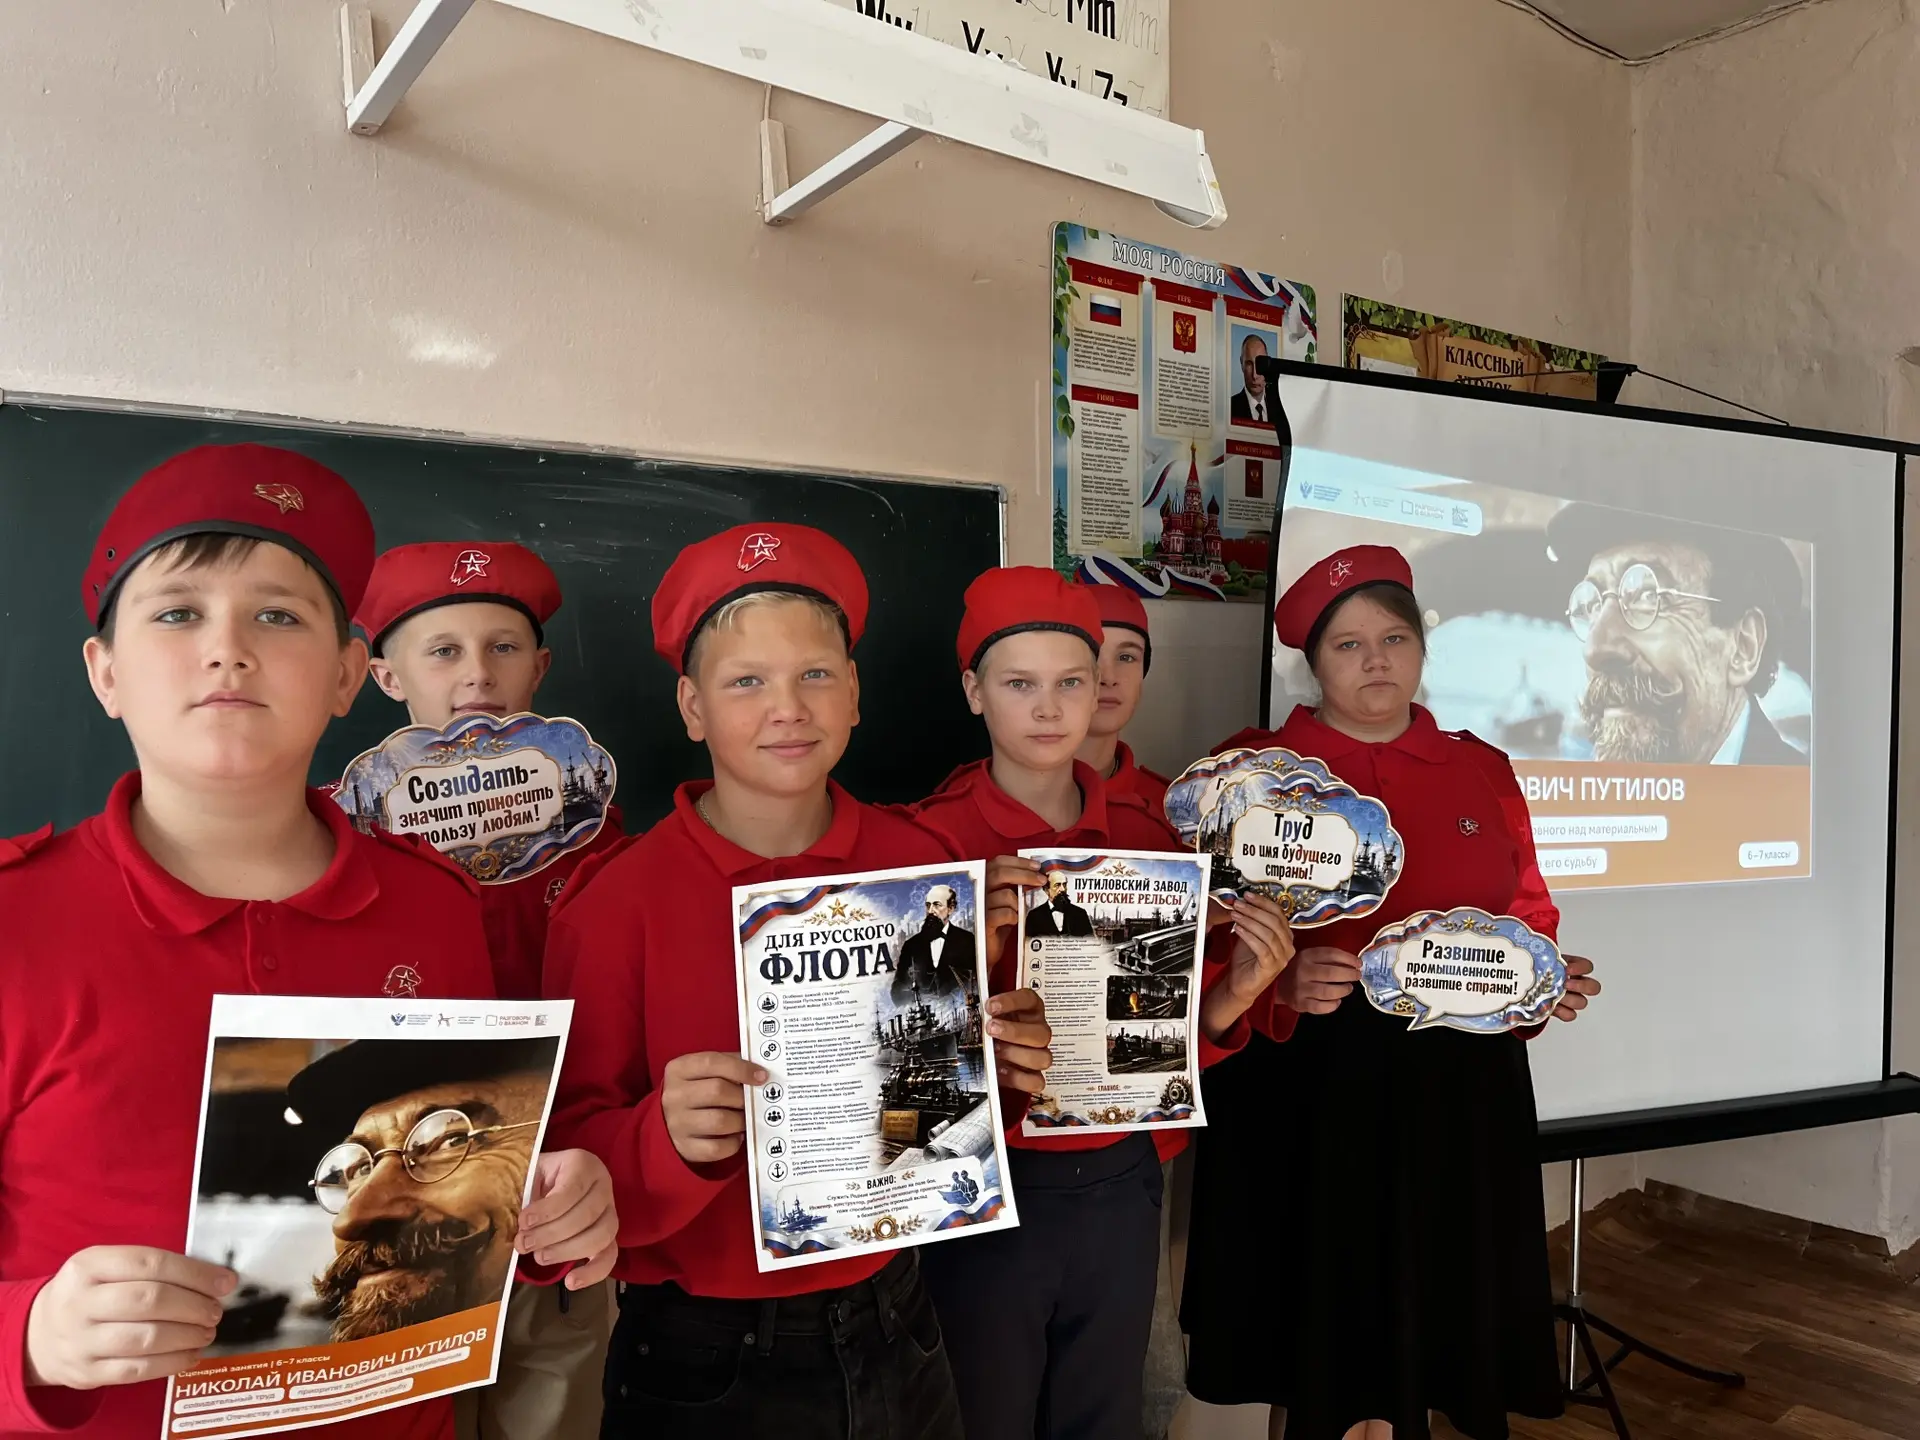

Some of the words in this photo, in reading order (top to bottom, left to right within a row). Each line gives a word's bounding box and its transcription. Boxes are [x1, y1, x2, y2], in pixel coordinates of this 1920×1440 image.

[1112, 240, 1153, 270] МОЯ
[1160, 252, 1226, 287] РОССИЯ
[1445, 345, 1524, 377] КЛАССНЫЙ
[1581, 777, 1685, 801] ПУТИЛОВ
[399, 803, 463, 828] значит
[467, 786, 554, 817] приносить
[483, 804, 540, 835] людям!
[1274, 813, 1314, 841] Труд
[1569, 825, 1586, 836] над
[1589, 824, 1658, 836] материальным
[1242, 843, 1256, 856] во
[1259, 844, 1279, 858] имя
[1282, 844, 1342, 865] будущего
[1544, 859, 1562, 870] его
[1565, 857, 1597, 870] судьбу
[1765, 849, 1791, 860] классы
[1265, 861, 1313, 881] страны!
[1074, 876, 1150, 892] ПУТИЛОВСКИЙ
[1153, 880, 1188, 893] ЗАВОД
[1076, 893, 1084, 904] И
[1087, 892, 1134, 904] РУССКИЕ
[1137, 893, 1182, 906] РЕЛЬСЫ
[764, 932, 805, 952] ДЛЯ
[810, 923, 895, 946] РУССКОГО
[1422, 940, 1505, 964] Развитие
[759, 942, 897, 986] ФЛОТА
[1404, 977, 1463, 992] развитие
[1466, 981, 1518, 996] страны!
[867, 1174, 896, 1189] ВАЖНО:
[175, 1371, 281, 1398] НИКОЛАЙ
[287, 1352, 396, 1385] ИВАНОВИЧ
[401, 1327, 487, 1361] ПУТИЛОВ
[178, 1366, 228, 1378] Сценарий
[230, 1362, 268, 1373] занятия
[296, 1355, 331, 1364] классы
[256, 1392, 276, 1401] труд
[226, 1410, 271, 1422] Отечеству
